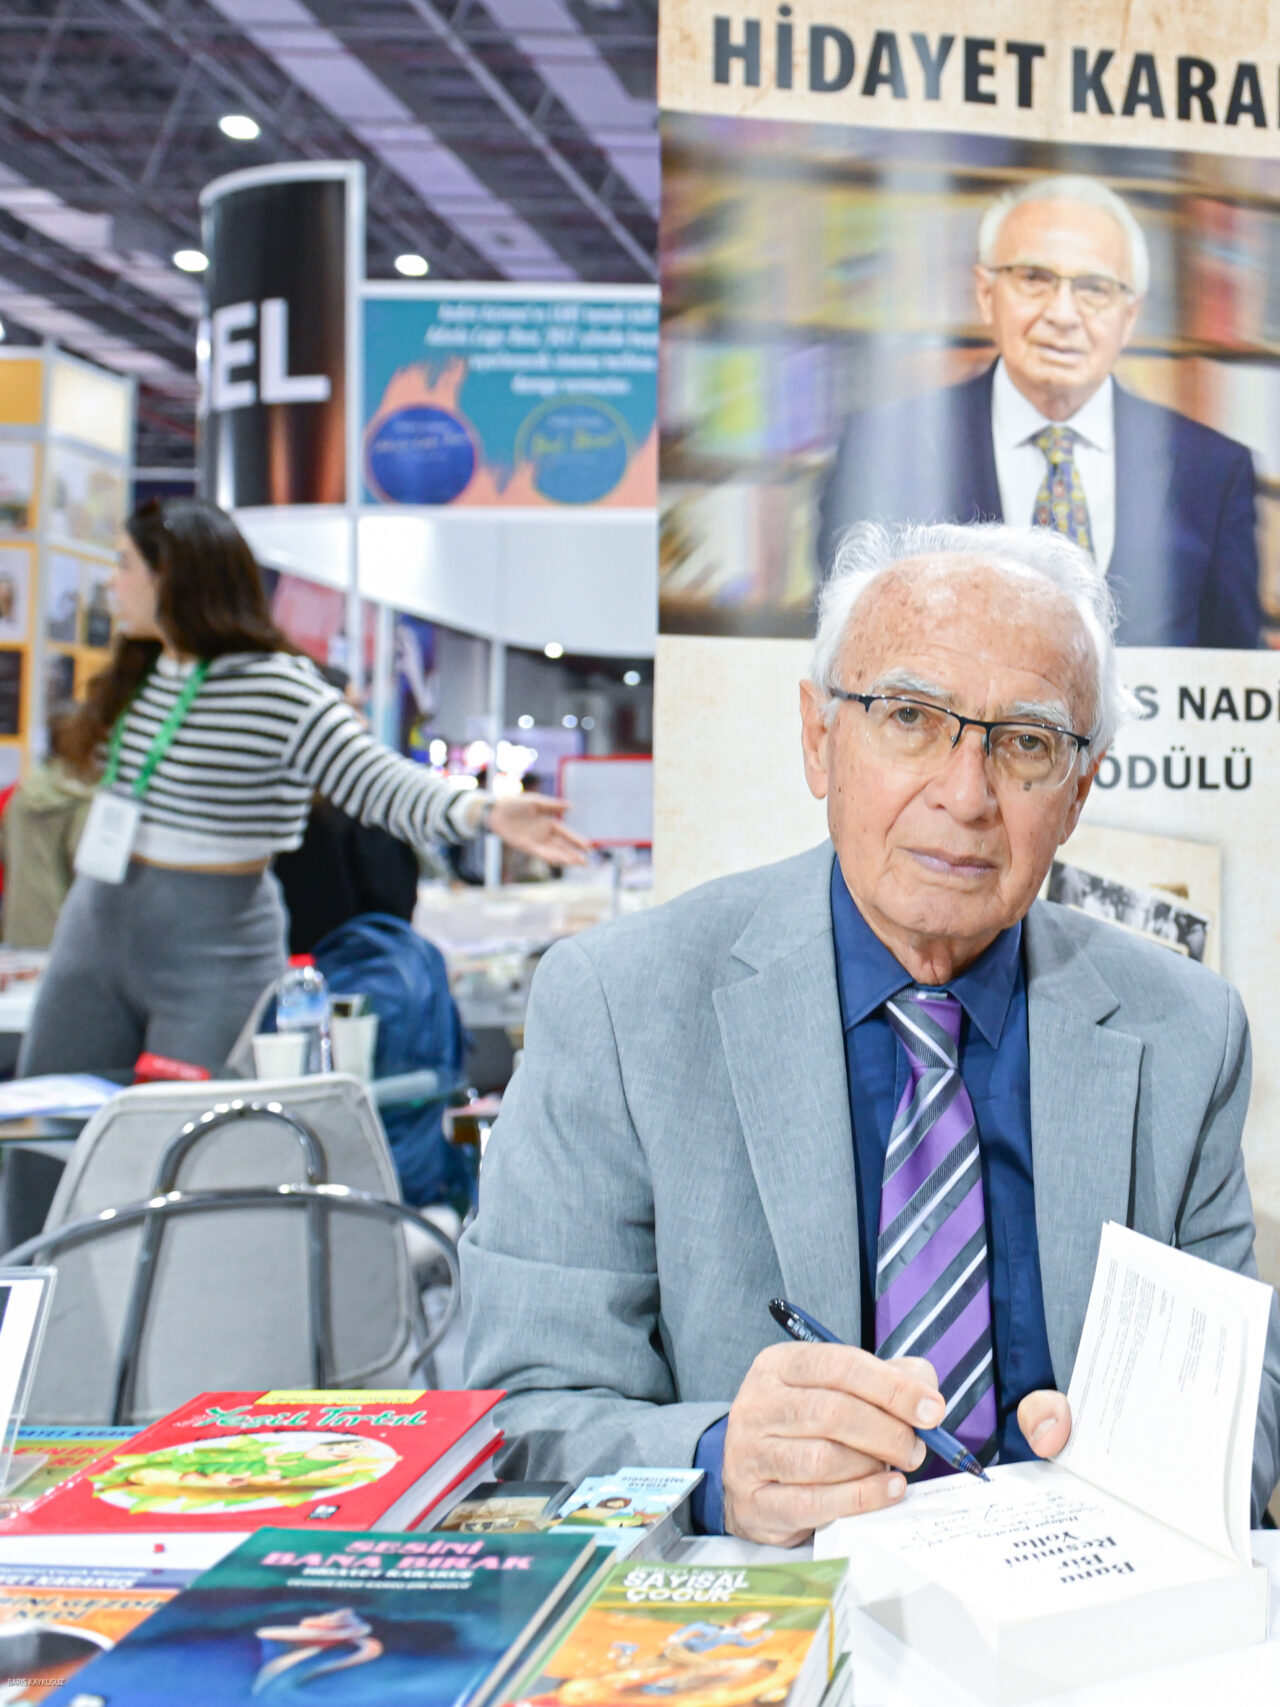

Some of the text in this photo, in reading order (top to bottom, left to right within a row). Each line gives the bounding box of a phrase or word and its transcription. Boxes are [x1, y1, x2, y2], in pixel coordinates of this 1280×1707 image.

[712, 5, 1045, 109] HİDAYET
[1126, 684, 1159, 720] S
[261, 1552, 382, 1568] BANA
[624, 1571, 749, 1588] SAYISAL
